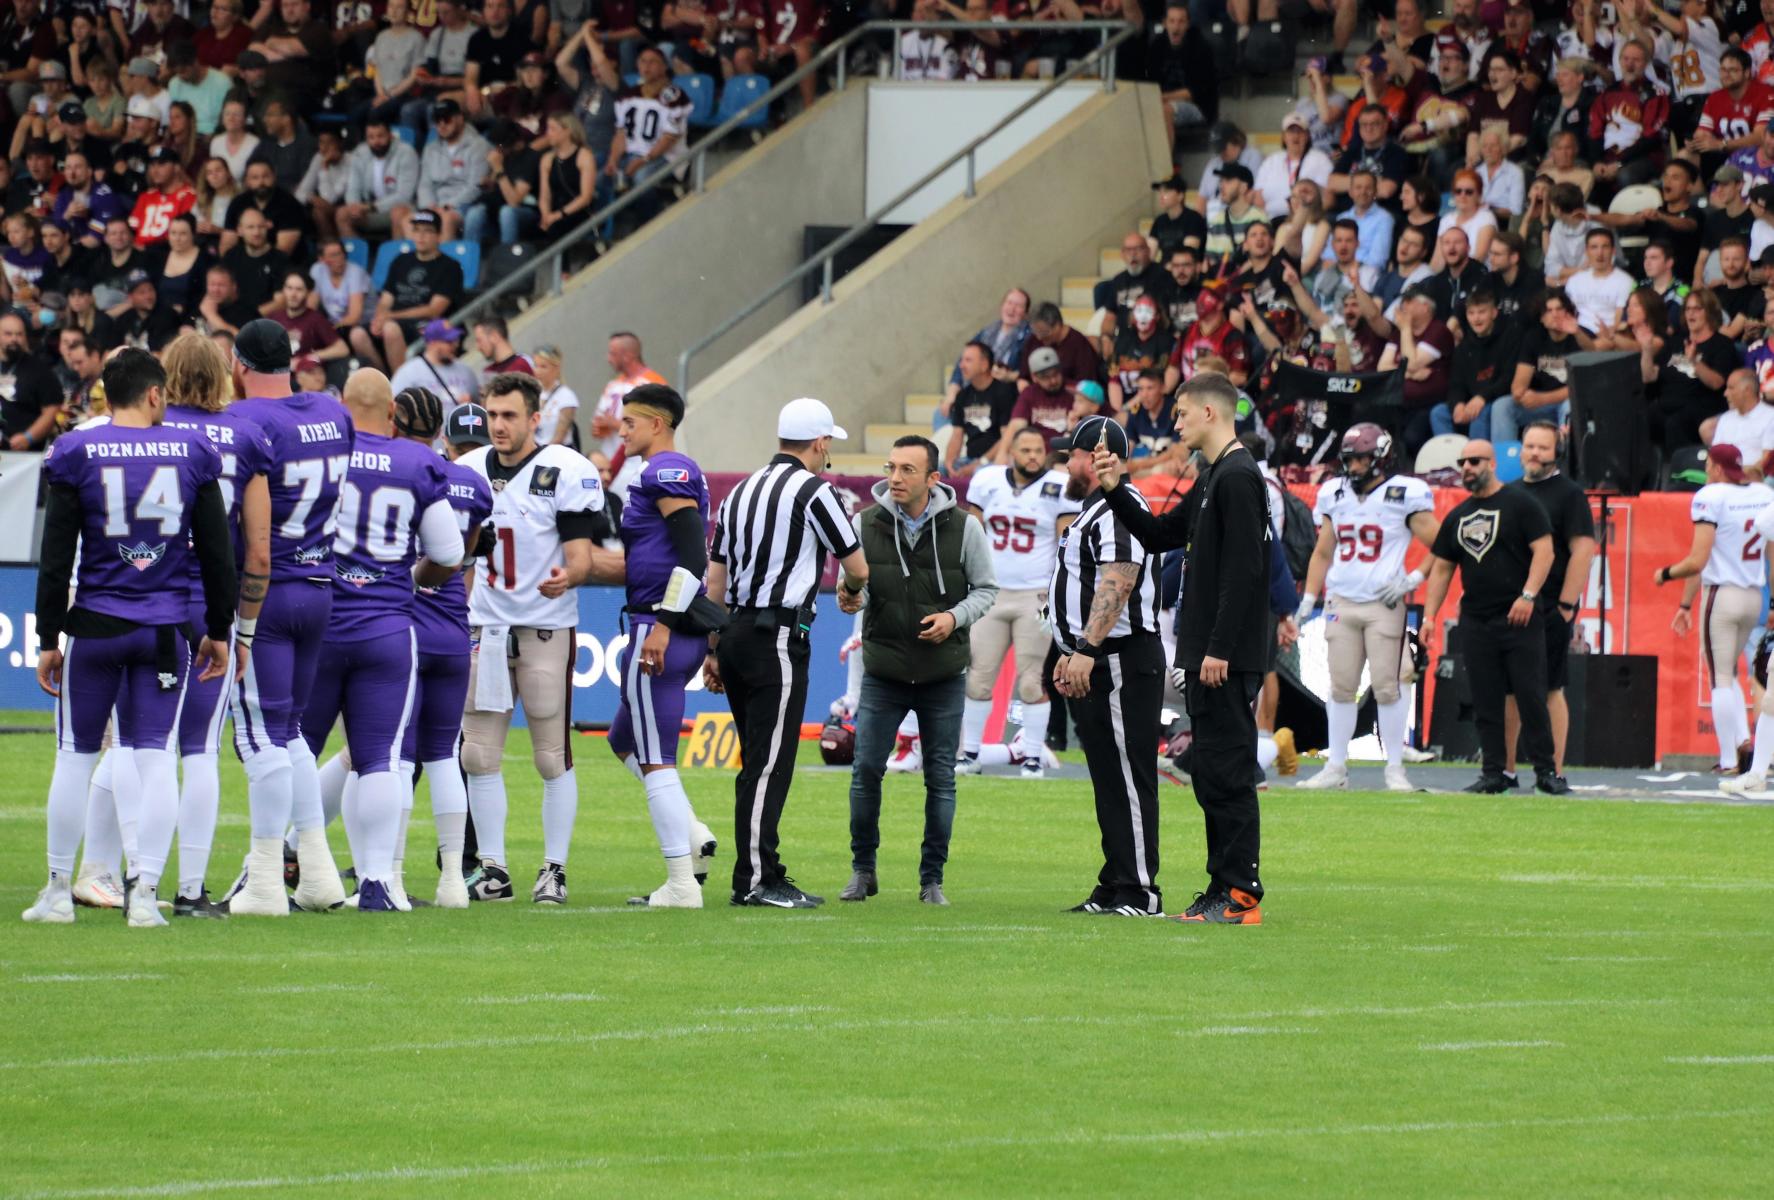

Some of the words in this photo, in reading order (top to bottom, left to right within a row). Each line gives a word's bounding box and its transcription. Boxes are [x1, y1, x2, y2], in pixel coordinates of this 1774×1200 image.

[142, 203, 173, 237] 15
[1327, 377, 1356, 393] SKLZ
[298, 421, 342, 443] KIEHL
[85, 442, 188, 459] POZNANSKI
[101, 466, 184, 537] 14
[447, 484, 475, 500] MEZ
[988, 514, 1037, 554] 95
[1337, 524, 1384, 563] 59
[131, 551, 153, 560] USA
[691, 720, 738, 767] 30
